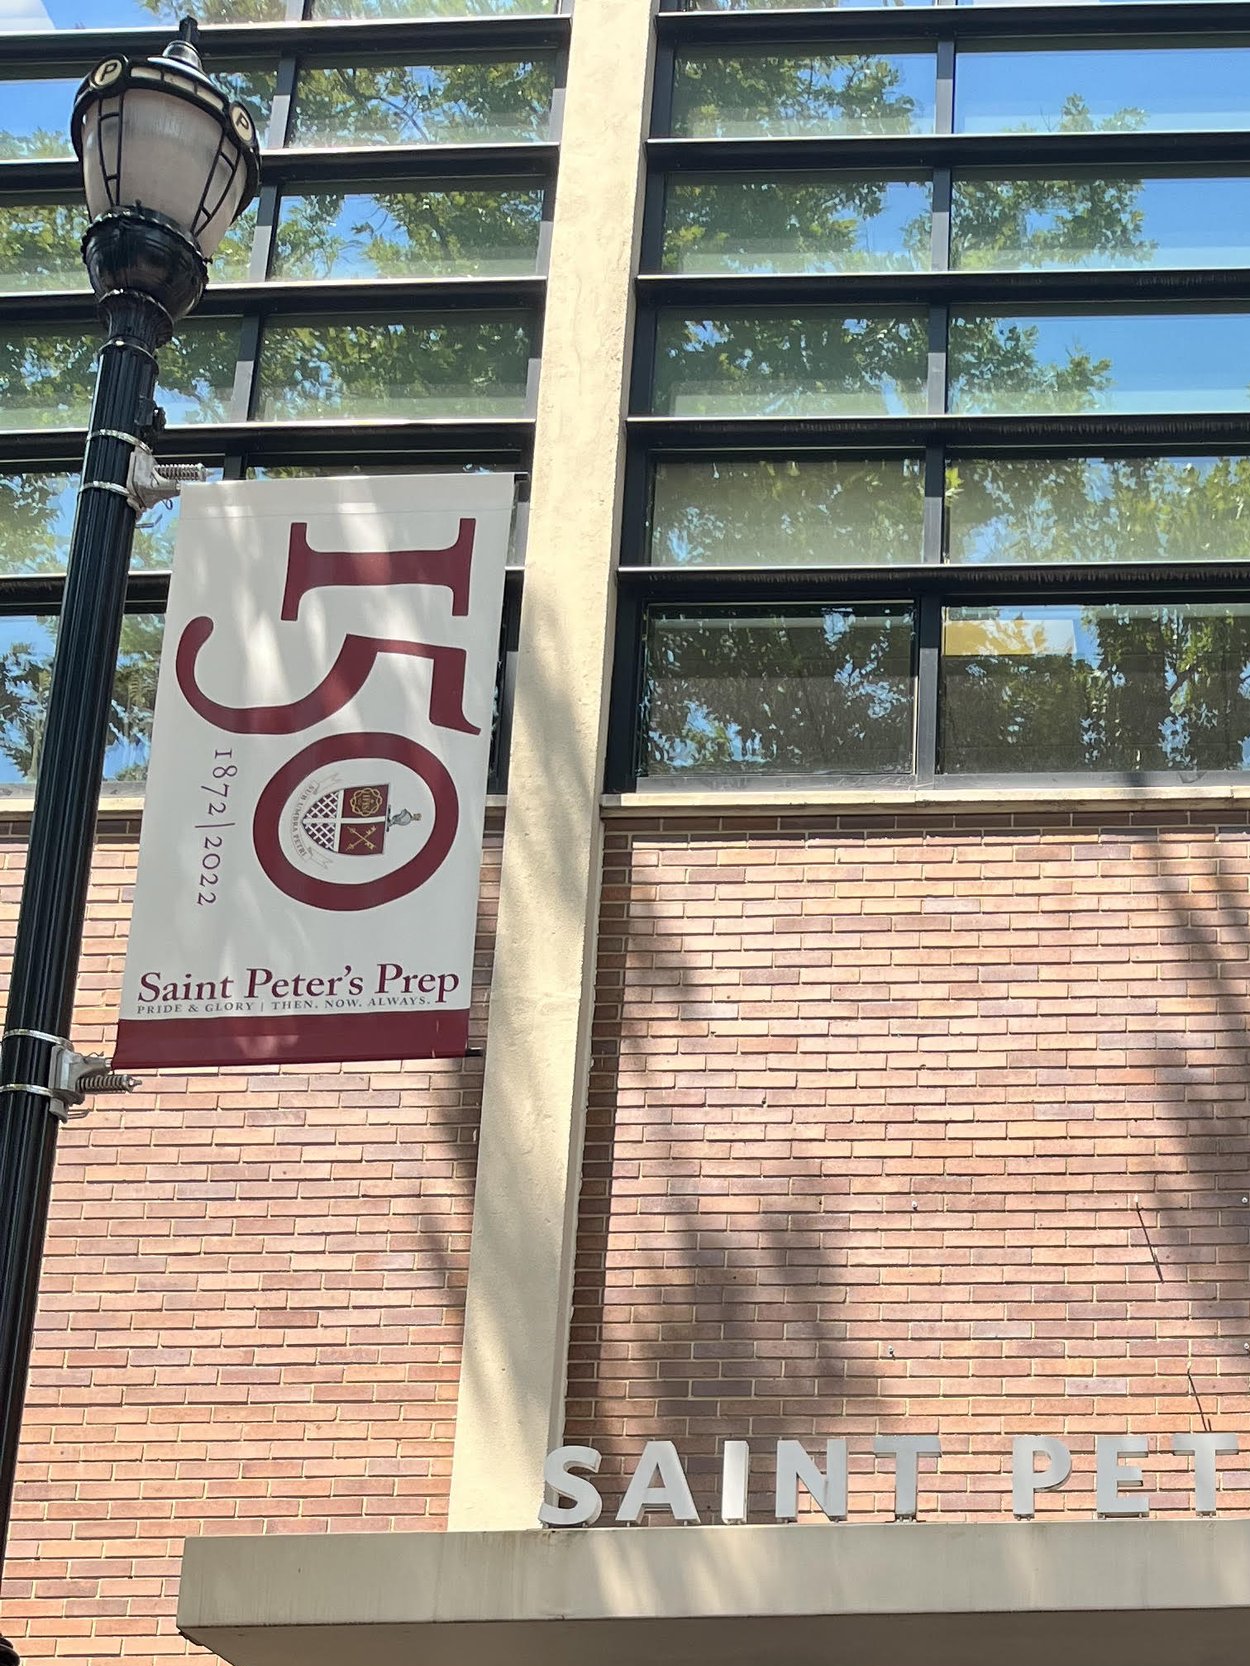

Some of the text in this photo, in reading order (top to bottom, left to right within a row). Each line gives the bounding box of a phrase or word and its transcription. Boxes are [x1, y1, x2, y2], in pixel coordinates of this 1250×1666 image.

[100, 62, 117, 82] P
[236, 112, 250, 130] P
[175, 517, 481, 911] 150
[300, 785, 315, 801] SUB
[293, 802, 304, 833] UMBRA
[138, 962, 461, 1005] Saint Peter's Prep
[136, 1004, 183, 1014] PRIDE
[188, 1003, 199, 1013] &
[204, 1002, 254, 1012] GLORY
[270, 1000, 318, 1011] THEN.
[324, 999, 362, 1010] NOW.
[367, 996, 431, 1007] ALWAYS.
[539, 1434, 942, 1525] SAINT
